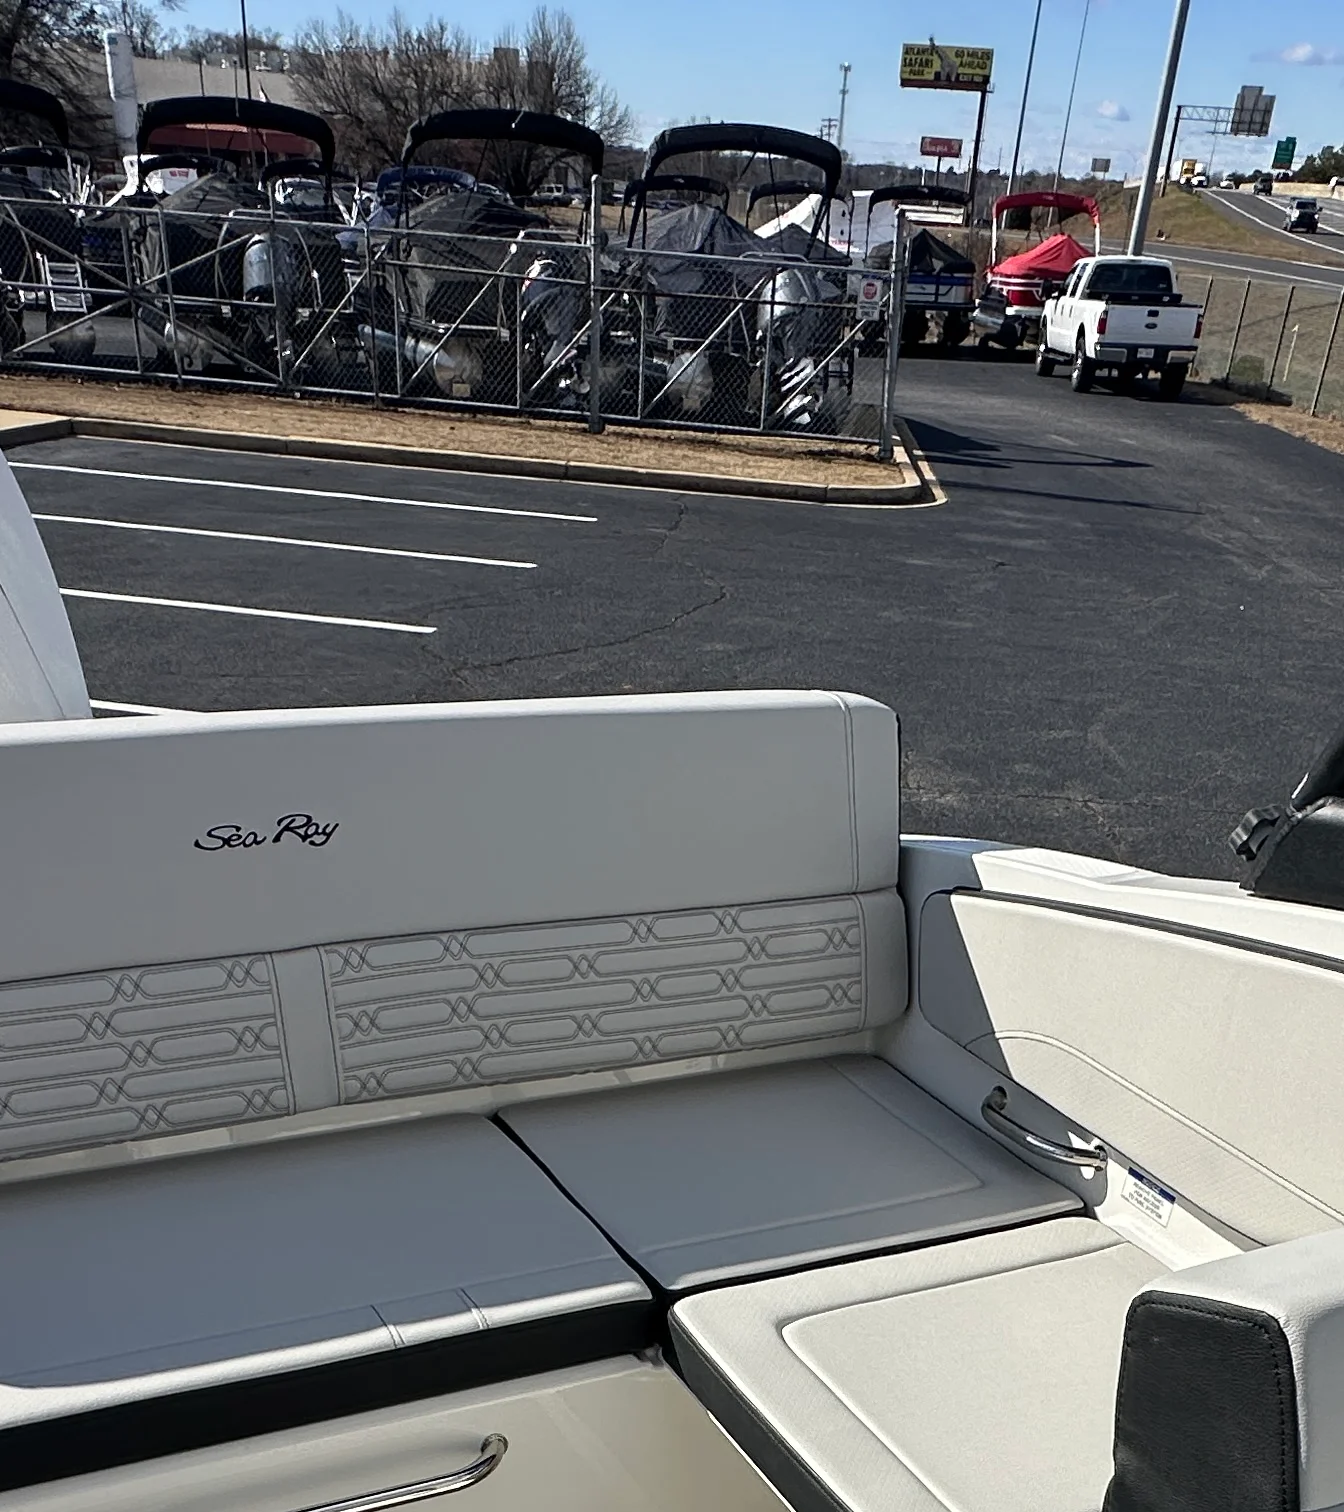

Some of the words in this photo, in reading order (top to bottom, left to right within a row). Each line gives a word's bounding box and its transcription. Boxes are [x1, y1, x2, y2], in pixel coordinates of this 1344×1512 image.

[903, 56, 933, 68] SAFARI
[194, 824, 267, 851] Sea
[271, 813, 340, 847] Ray
